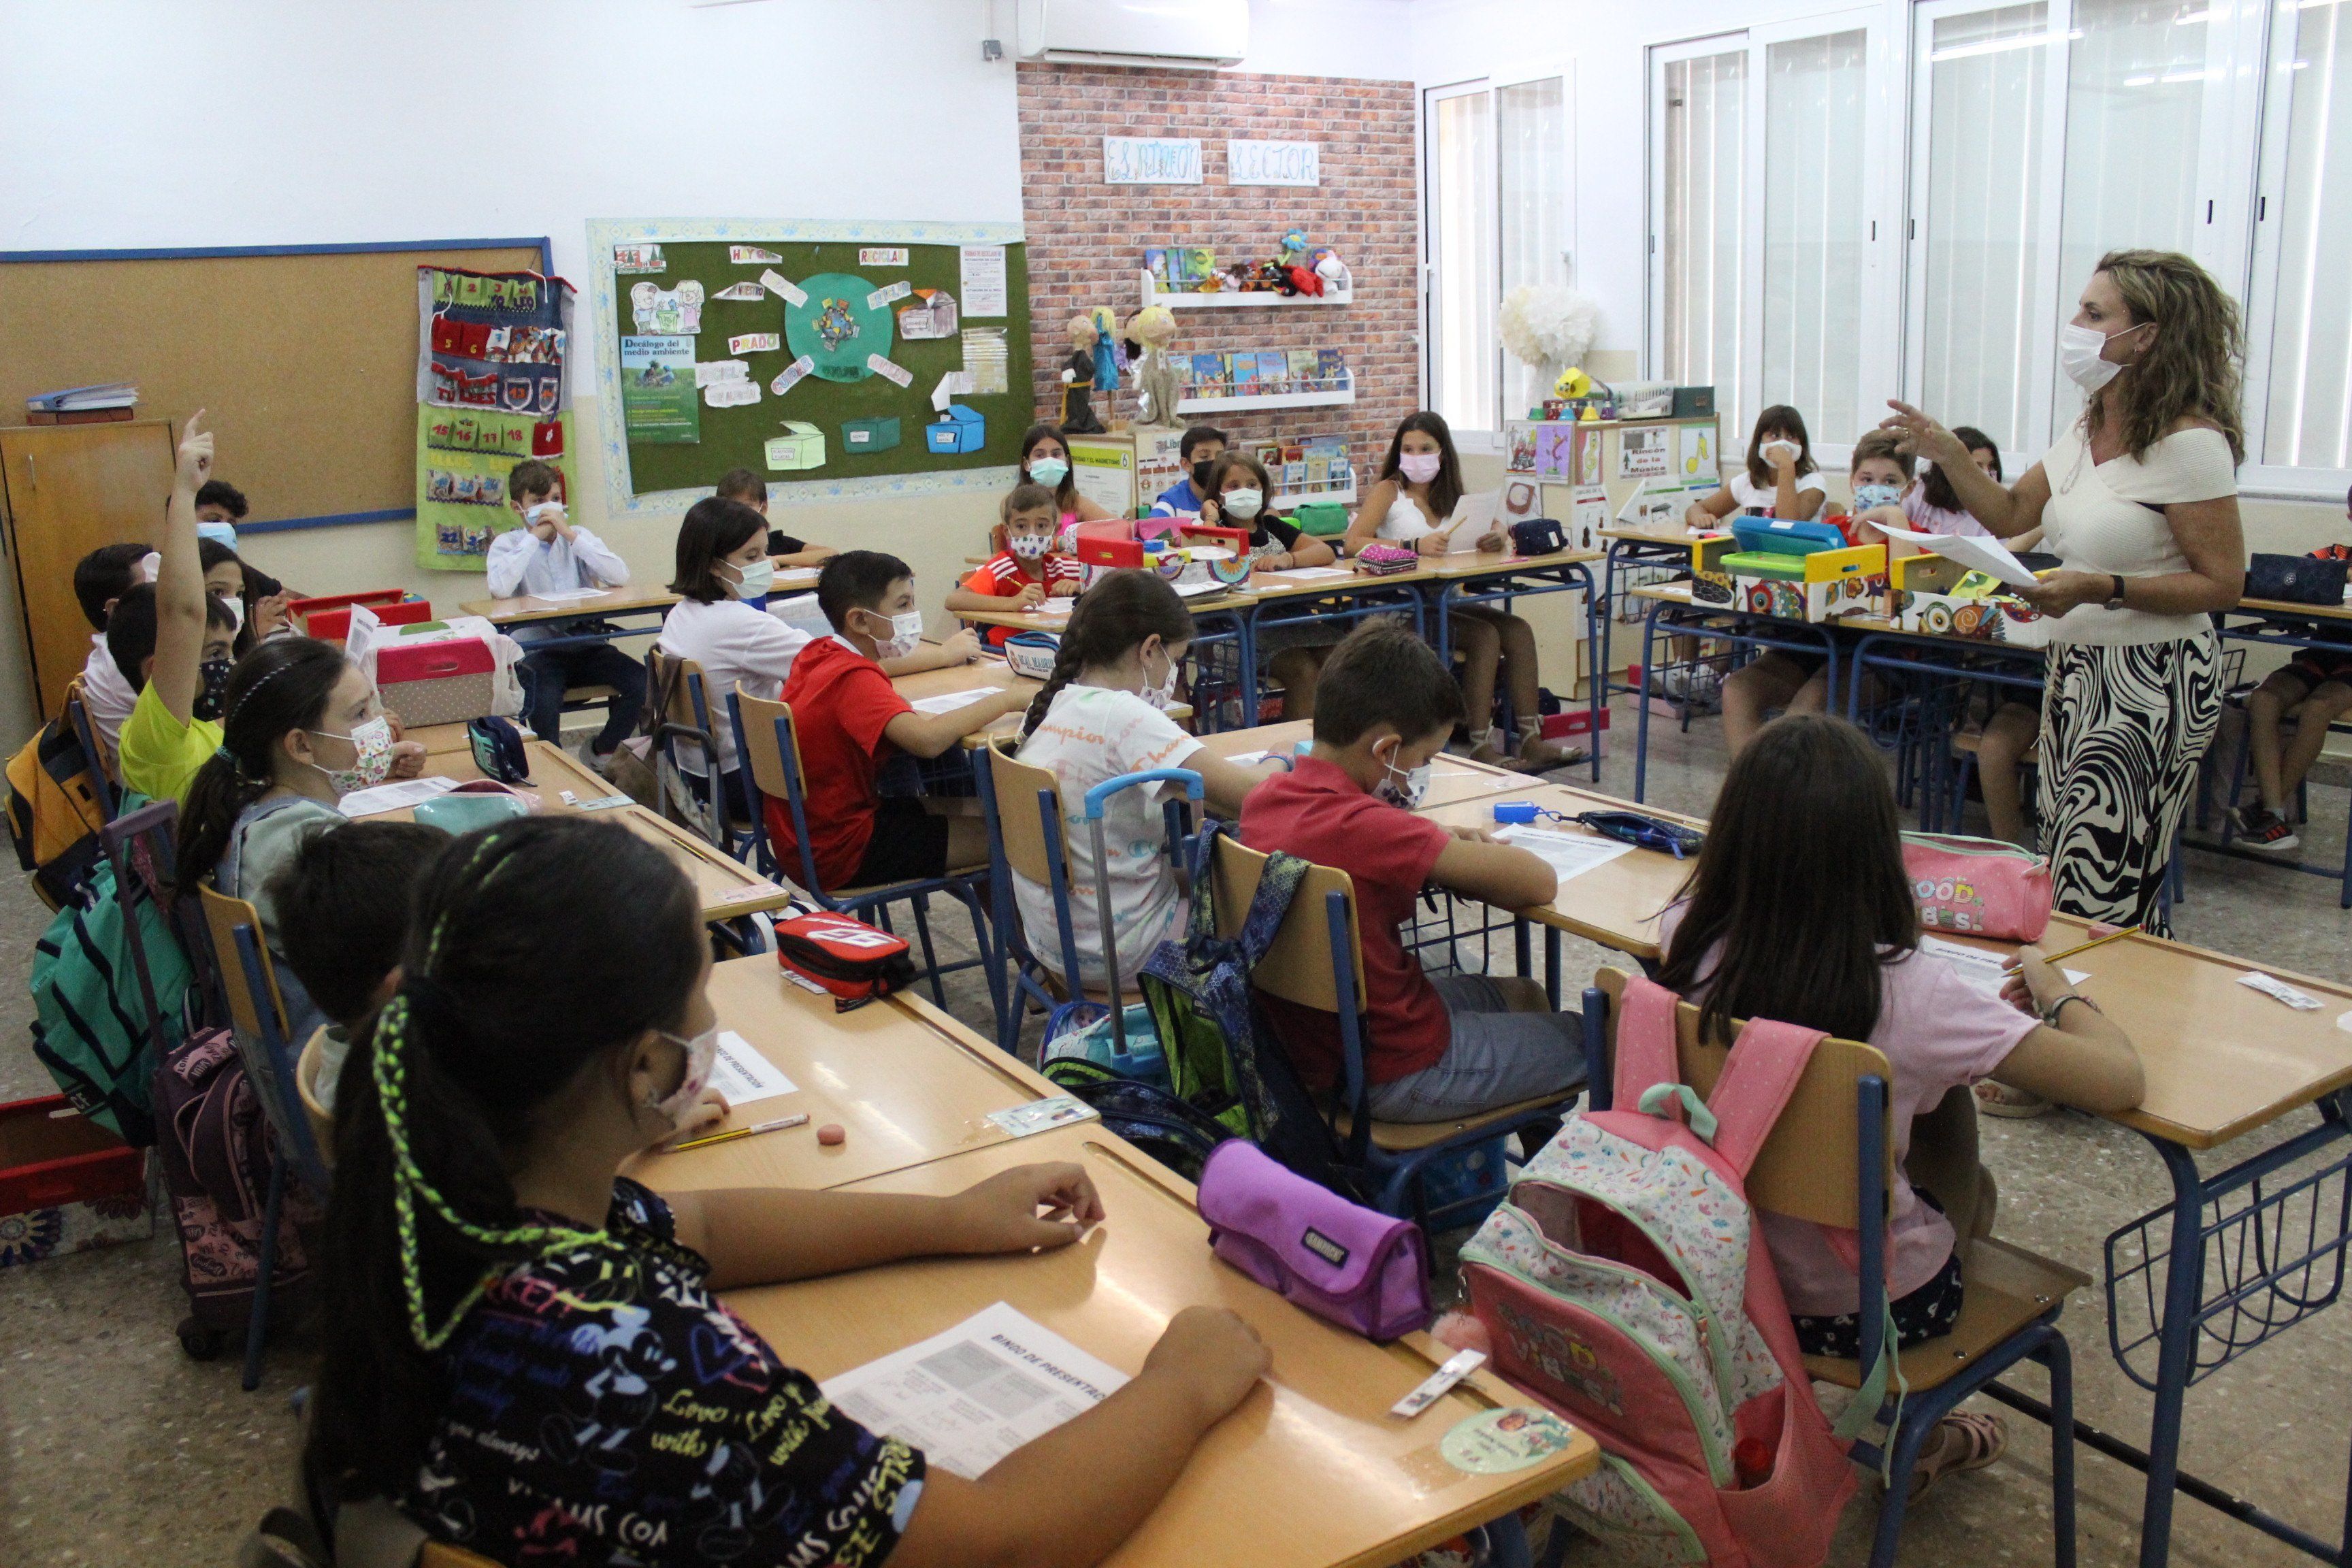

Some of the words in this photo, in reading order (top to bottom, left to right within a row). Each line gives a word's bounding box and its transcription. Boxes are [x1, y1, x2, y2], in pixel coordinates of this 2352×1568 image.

[733, 249, 754, 260] HAY
[861, 250, 904, 263] RECICLAR
[468, 283, 476, 293] 2
[494, 283, 502, 293] 3
[513, 295, 534, 308] LEO
[445, 339, 452, 348] 5
[470, 344, 477, 354] 6
[625, 339, 664, 348] Decálogo
[732, 335, 777, 353] PRADO
[772, 357, 812, 393] CUIDAR
[510, 387, 525, 399] 13
[457, 430, 471, 441] 16
[483, 432, 497, 443] 17
[507, 429, 523, 441] 18
[1017, 654, 1032, 667] REAL
[1936, 947, 1966, 958] BINGO
[990, 1333, 1028, 1356] BINGO
[1025, 1351, 1044, 1365] DE
